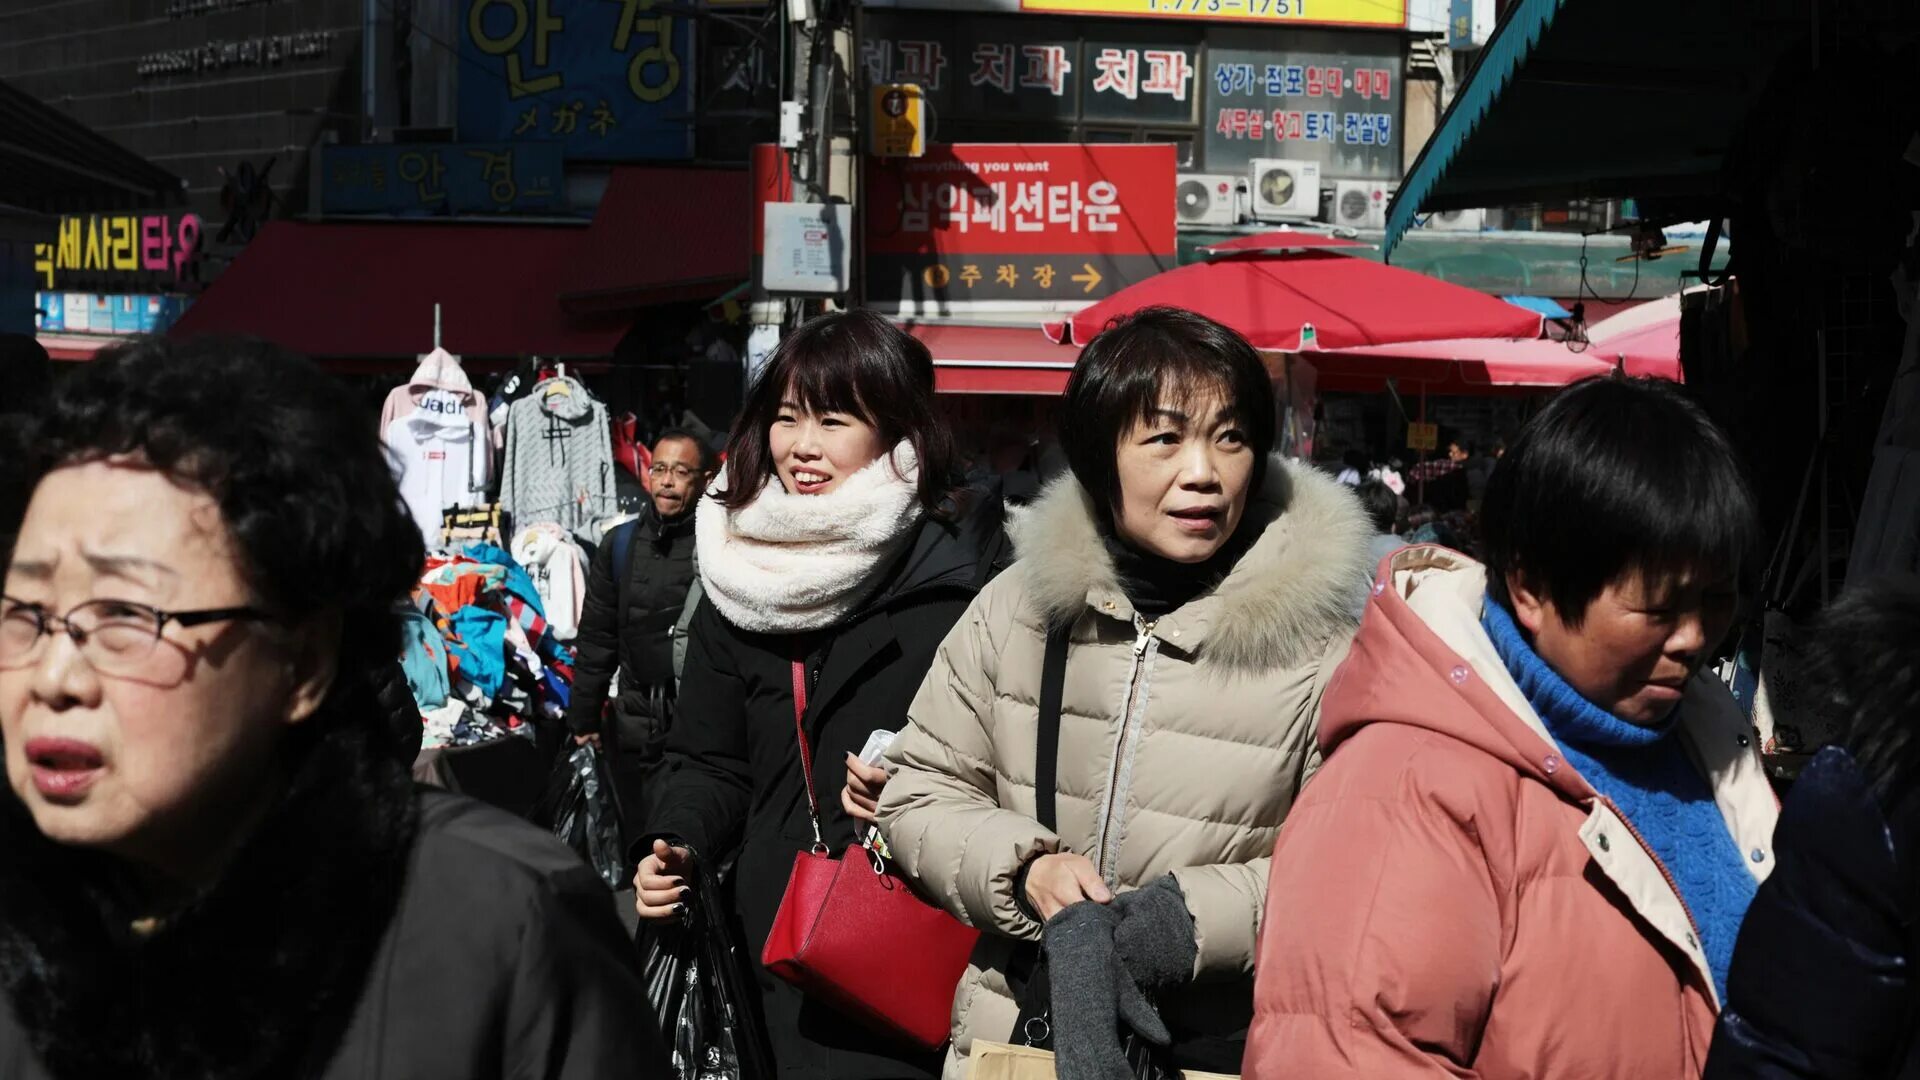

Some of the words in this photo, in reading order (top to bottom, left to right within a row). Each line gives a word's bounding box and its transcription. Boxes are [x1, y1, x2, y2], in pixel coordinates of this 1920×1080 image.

[970, 44, 1071, 96] 치과
[1093, 49, 1193, 101] 치과
[514, 101, 616, 138] メガネ
[983, 162, 1009, 174] you
[1013, 161, 1050, 172] want
[897, 180, 1121, 233] 삼익패션타운
